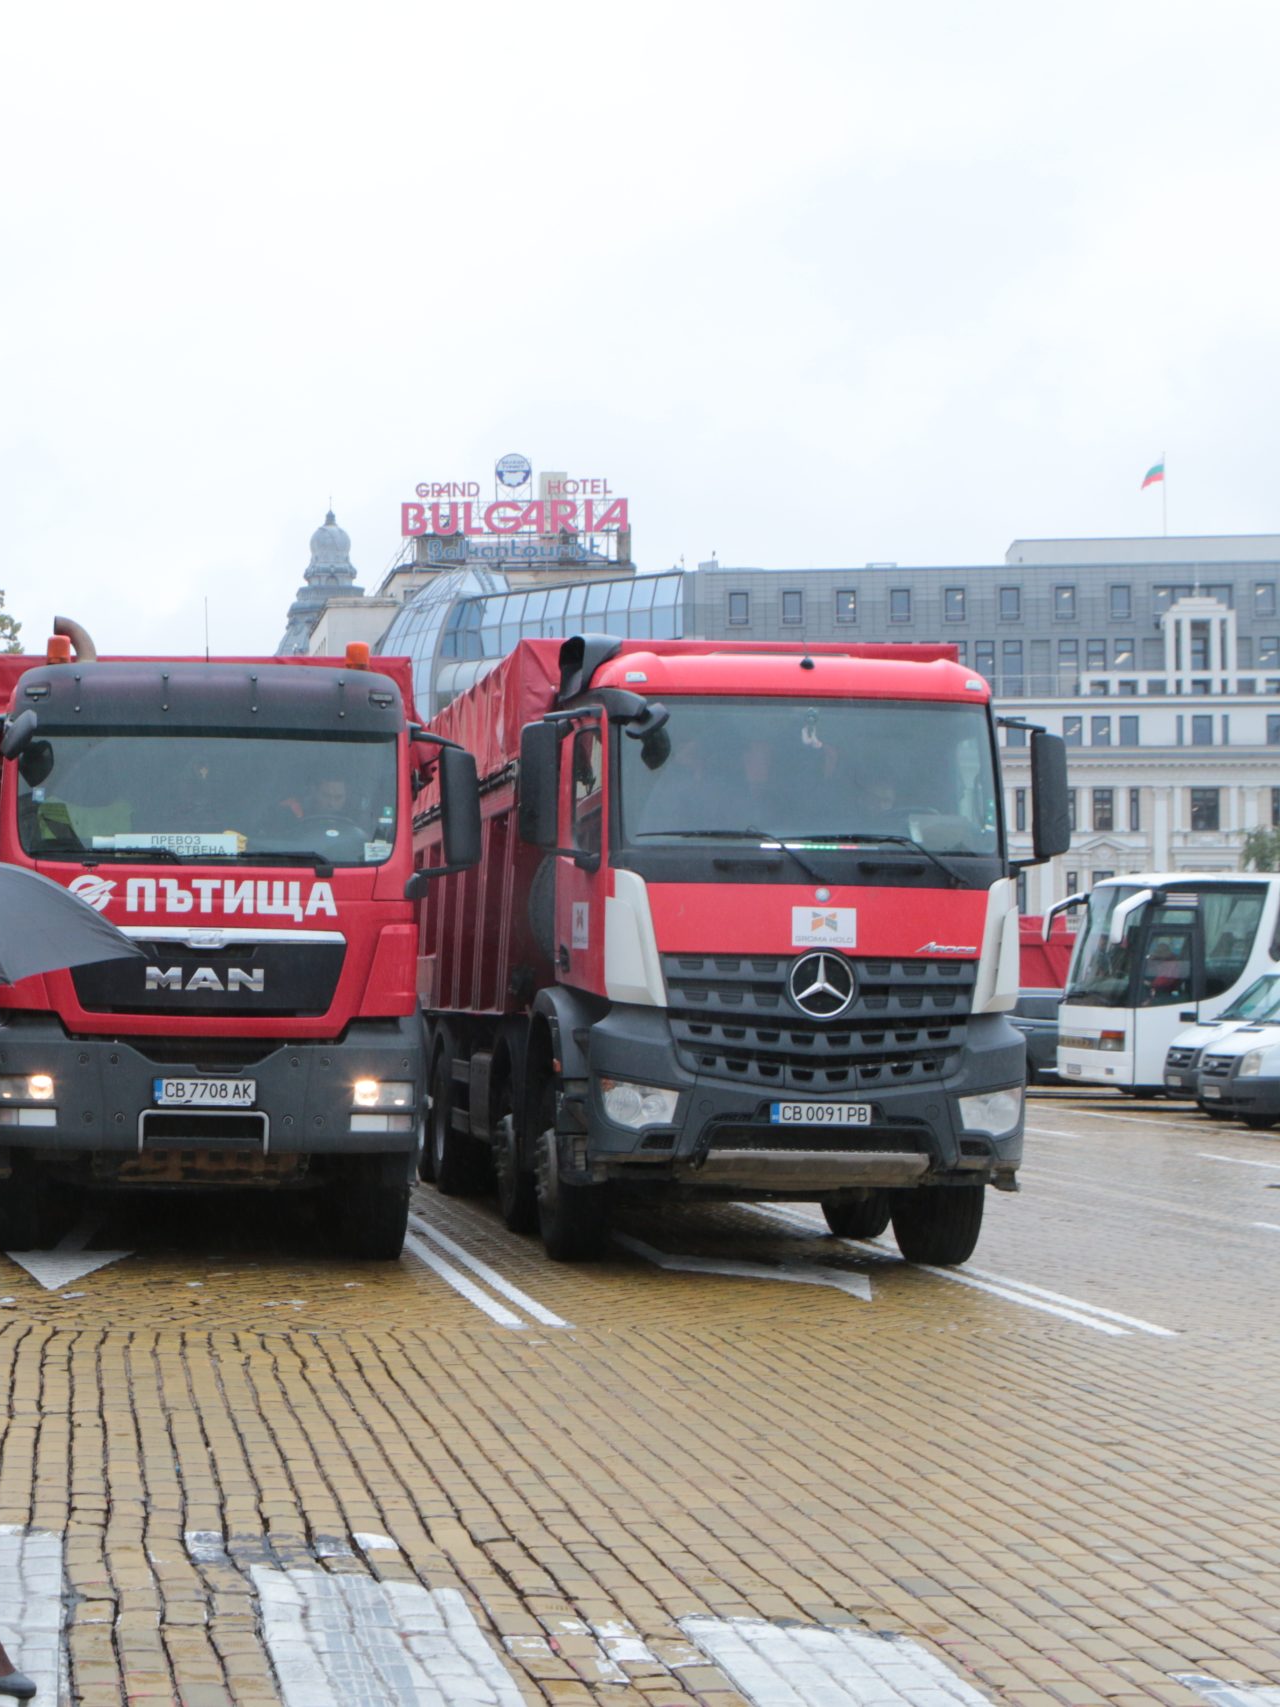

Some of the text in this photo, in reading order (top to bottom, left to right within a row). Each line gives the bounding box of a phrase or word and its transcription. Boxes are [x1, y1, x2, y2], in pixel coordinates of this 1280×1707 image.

[415, 478, 613, 498] GRAND HOTEL
[401, 497, 629, 537] BULGARIA
[150, 835, 201, 845] ПРЕВОЗ
[125, 877, 339, 923] ПЪТИЩА
[144, 965, 265, 992] MAN
